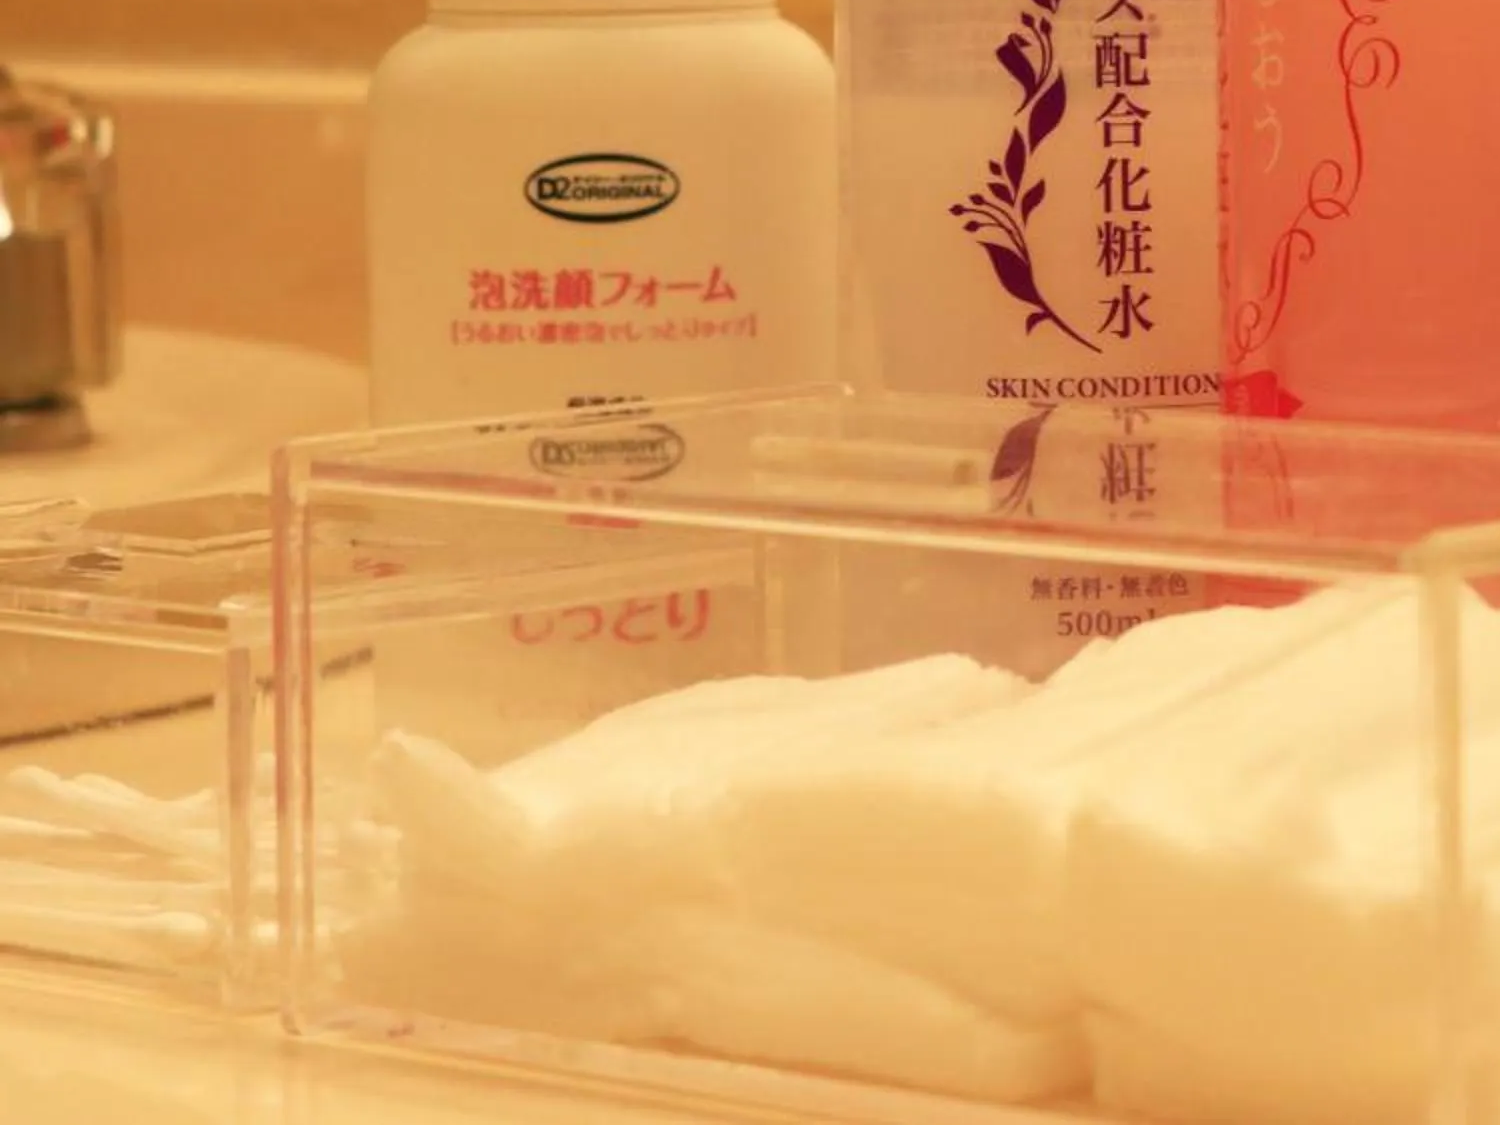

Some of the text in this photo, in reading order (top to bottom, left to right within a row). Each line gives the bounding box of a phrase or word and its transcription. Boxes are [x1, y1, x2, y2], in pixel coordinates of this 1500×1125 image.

[573, 183, 664, 201] ORIGINAL
[469, 265, 738, 312] 泡洗顔フォーム
[986, 377, 1051, 399] SKIN
